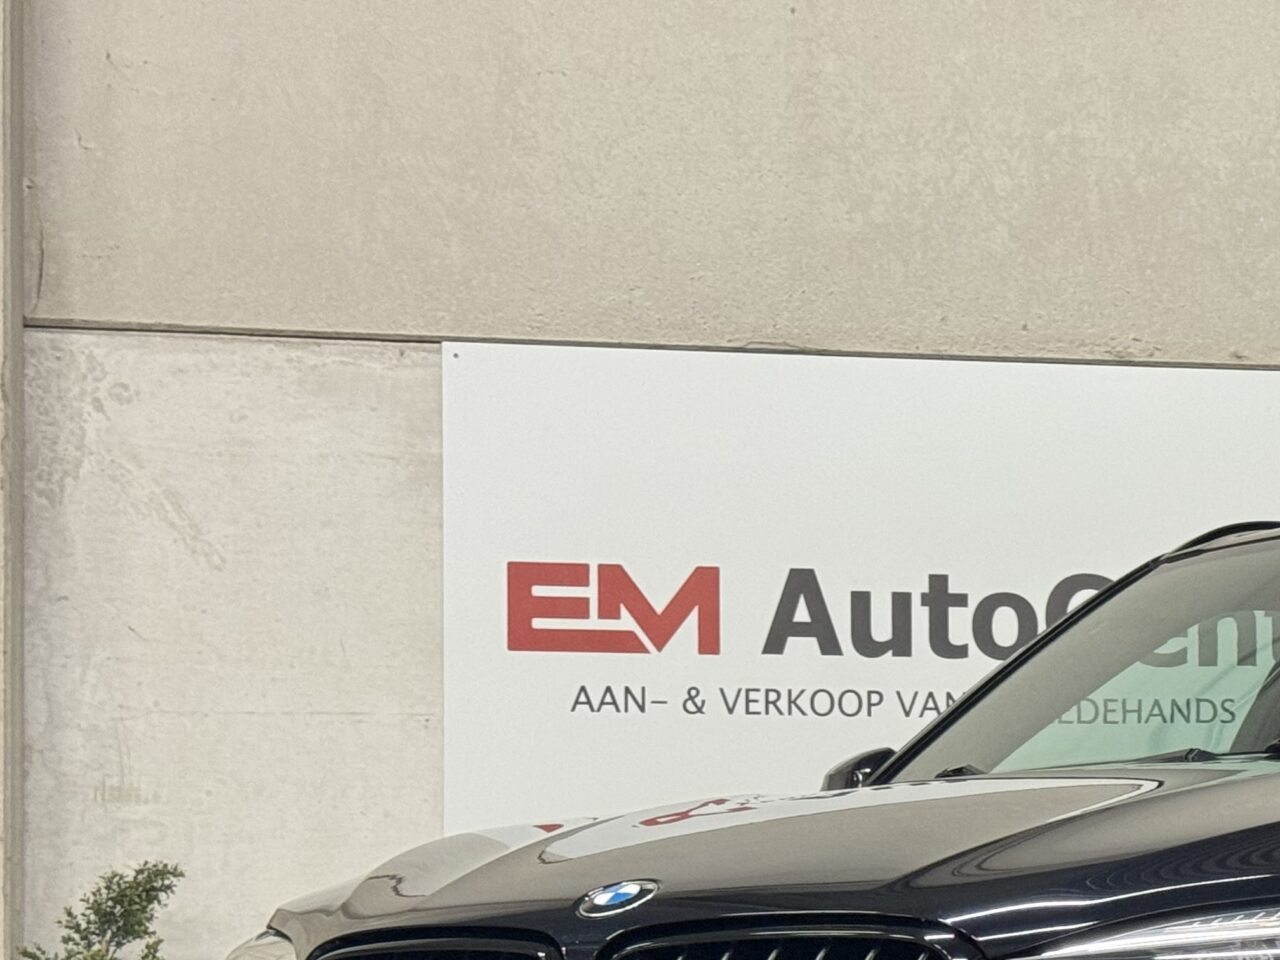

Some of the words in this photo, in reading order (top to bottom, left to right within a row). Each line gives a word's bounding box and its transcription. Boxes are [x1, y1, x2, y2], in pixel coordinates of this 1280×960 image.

[507, 561, 720, 655] EM
[570, 685, 668, 713] AAN-
[682, 686, 706, 715] &
[719, 688, 884, 718] VERKOOP
[1053, 698, 1237, 724] DEHANDS
